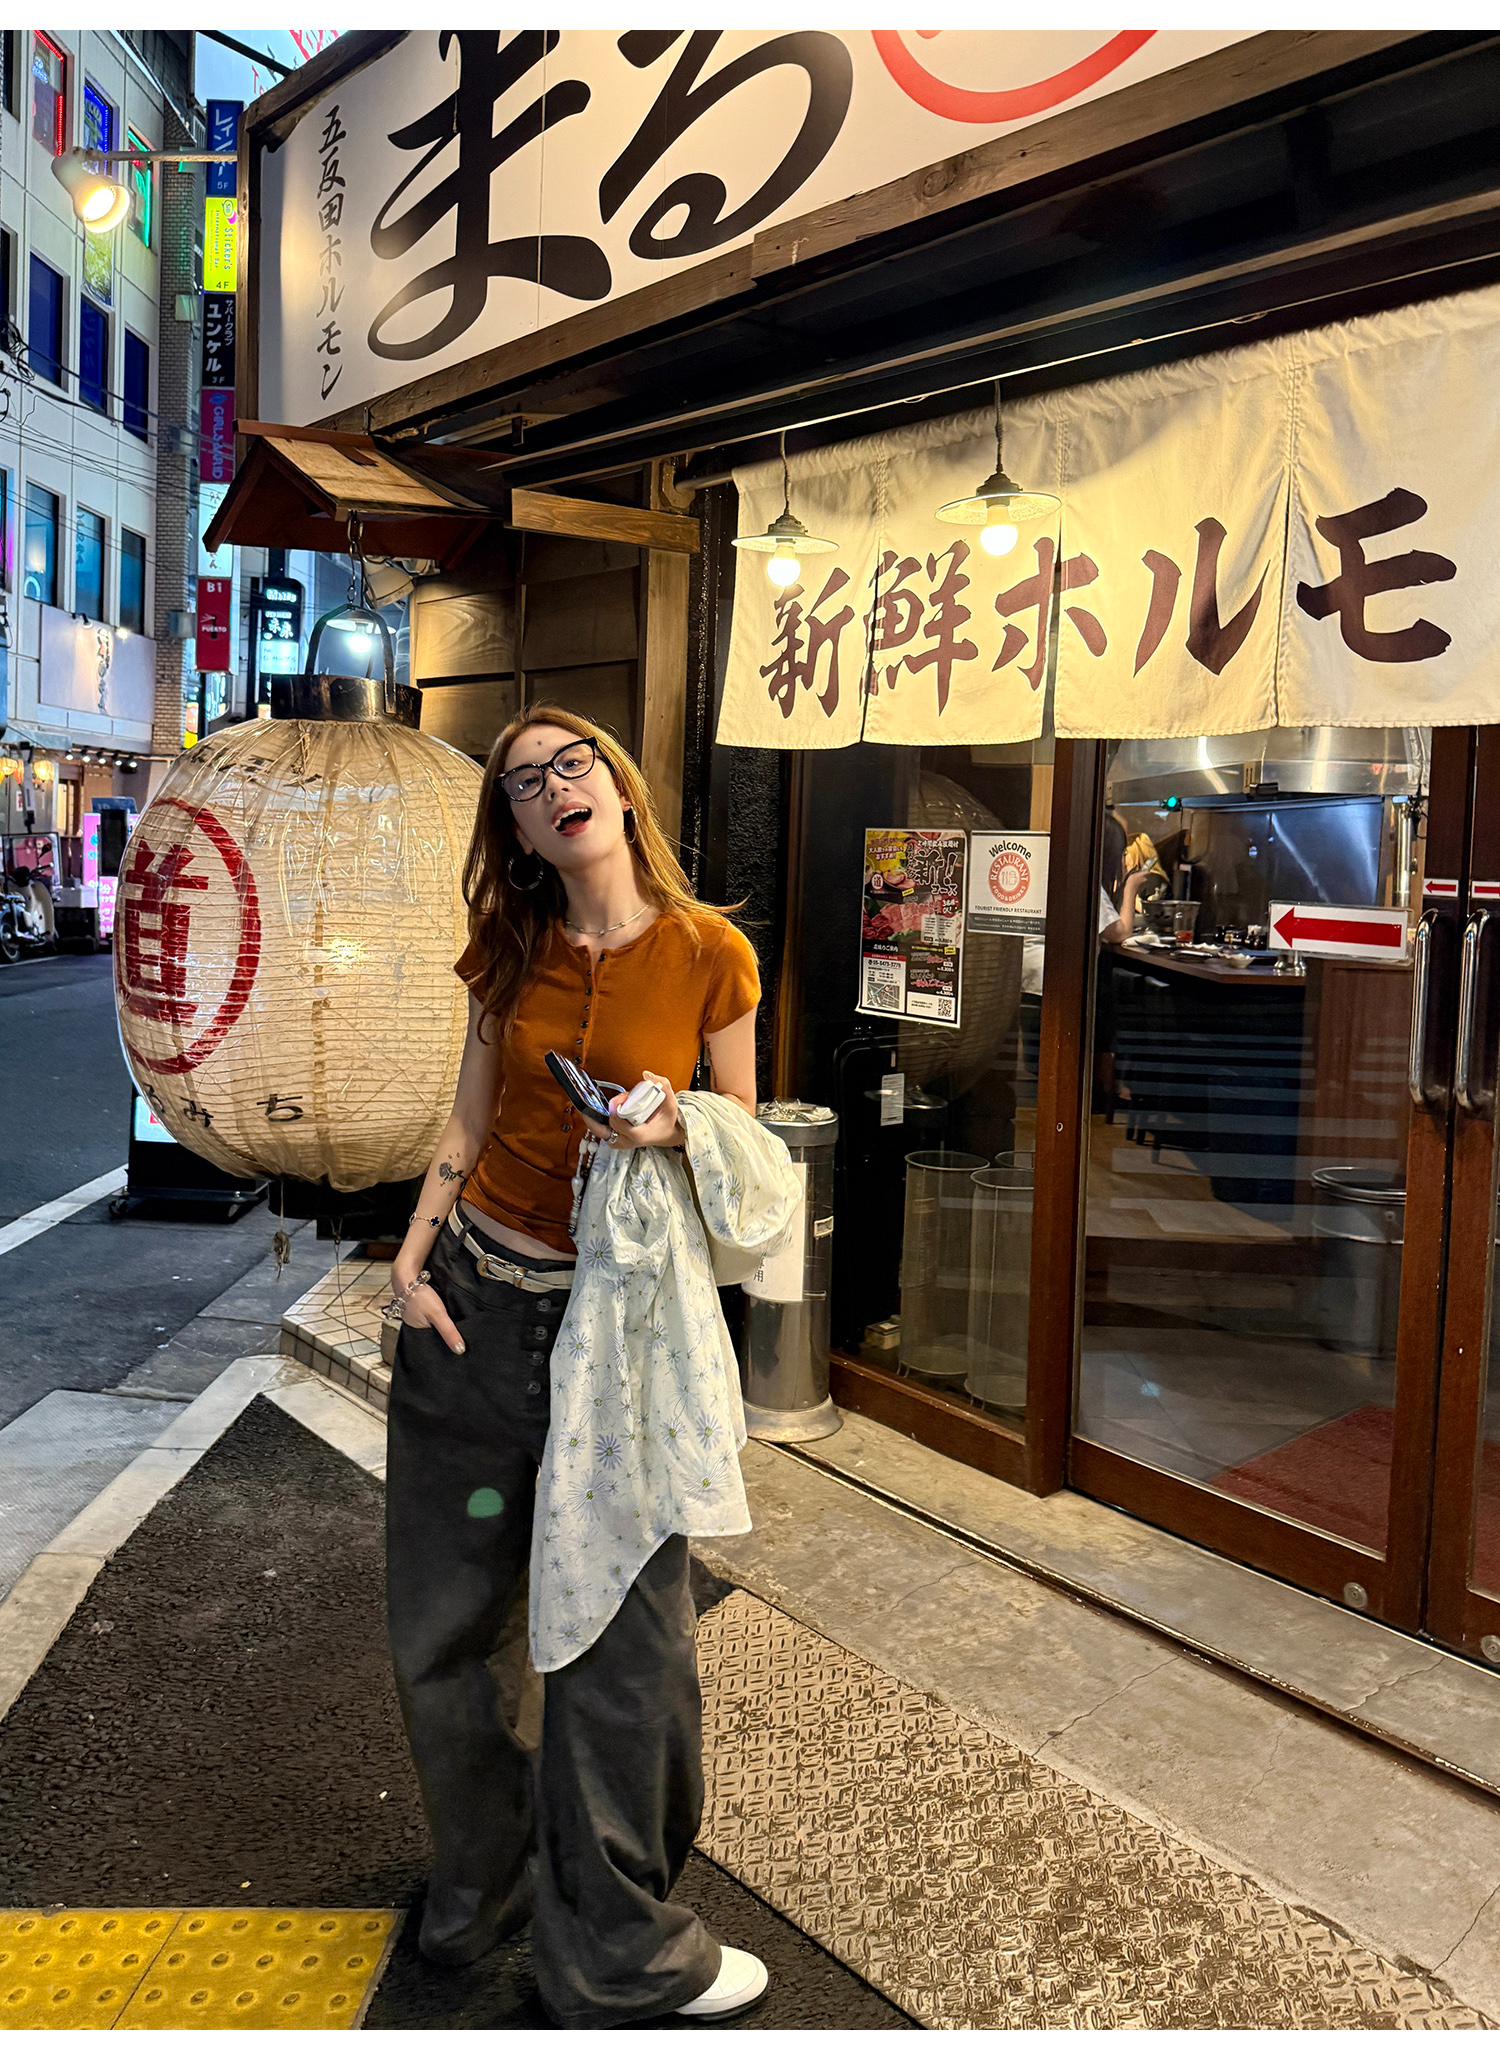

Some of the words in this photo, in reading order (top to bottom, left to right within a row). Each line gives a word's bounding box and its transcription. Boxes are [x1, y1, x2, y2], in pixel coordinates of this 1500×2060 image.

[217, 181, 229, 190] 5F
[223, 227, 234, 270] Sticker's
[315, 104, 347, 401] 五反田ホルモン
[216, 281, 230, 289] 4F
[206, 303, 222, 372] ユンケル
[211, 376, 225, 384] 3F
[758, 486, 1458, 719] 新鮮ホルモ
[988, 839, 1032, 860] Welcome
[990, 854, 1029, 881] RESTAURANT
[992, 885, 1026, 902] FOOD&DRINKS
